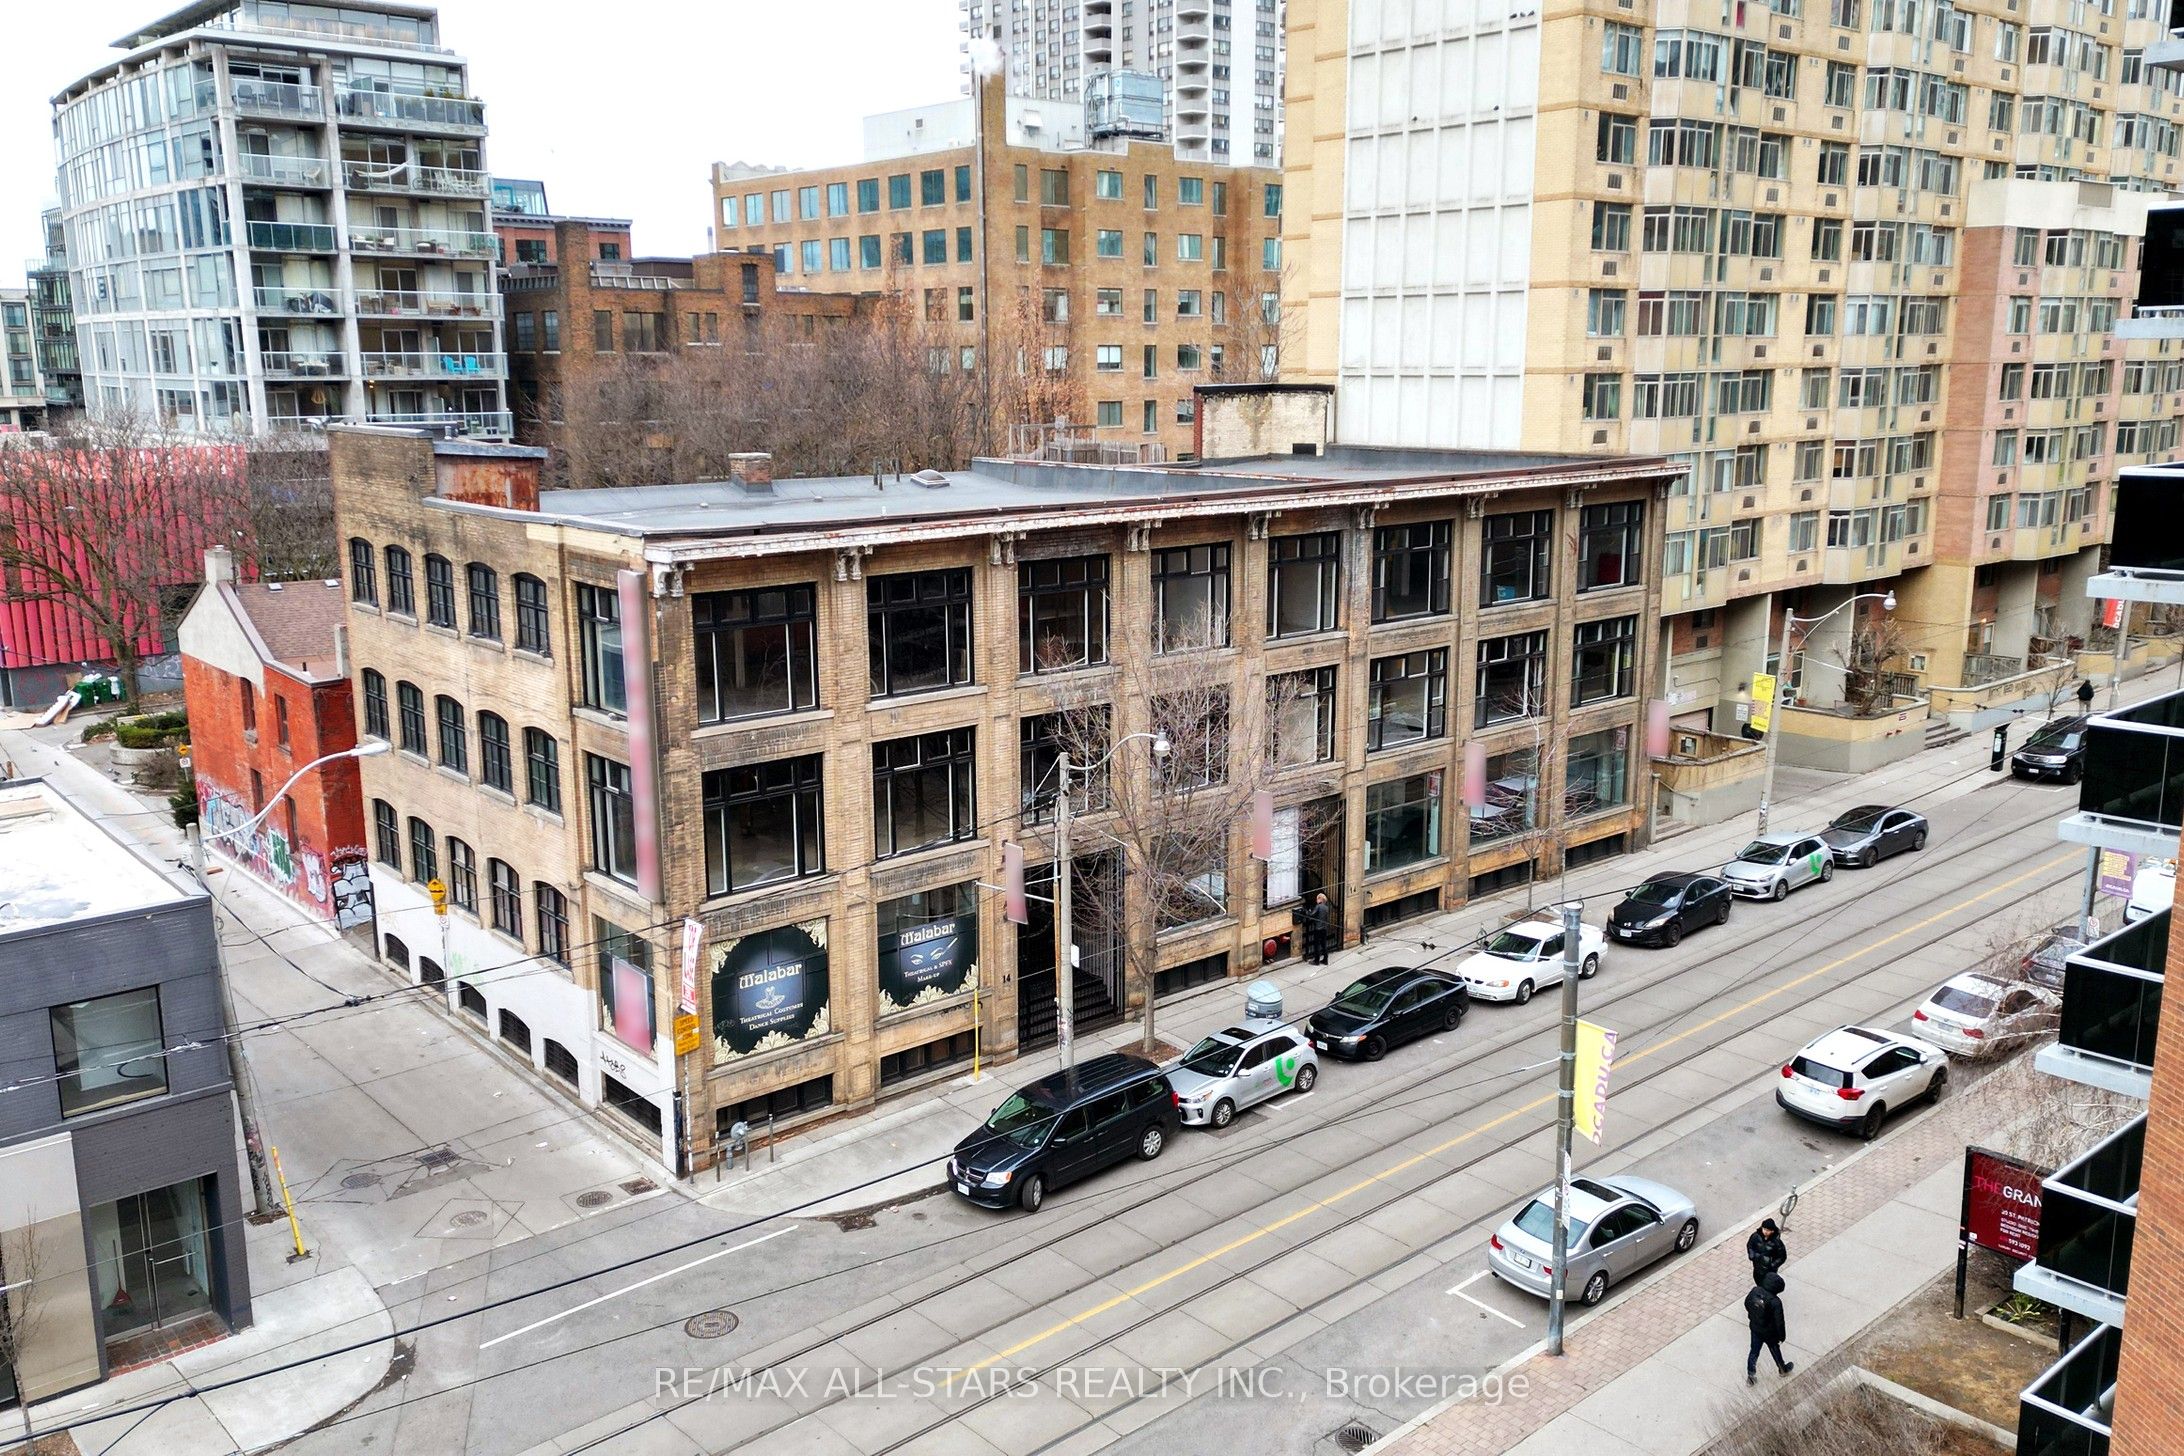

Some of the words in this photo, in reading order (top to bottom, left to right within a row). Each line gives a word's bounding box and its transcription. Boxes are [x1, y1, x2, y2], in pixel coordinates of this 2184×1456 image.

[900, 923, 955, 946] Malabar
[739, 963, 802, 990] Malabar
[740, 1011, 772, 1024] THEATRICAL
[749, 1021, 769, 1031] DANCE
[770, 1013, 795, 1025] SUPPLIES
[1974, 1175, 2002, 1195] THE
